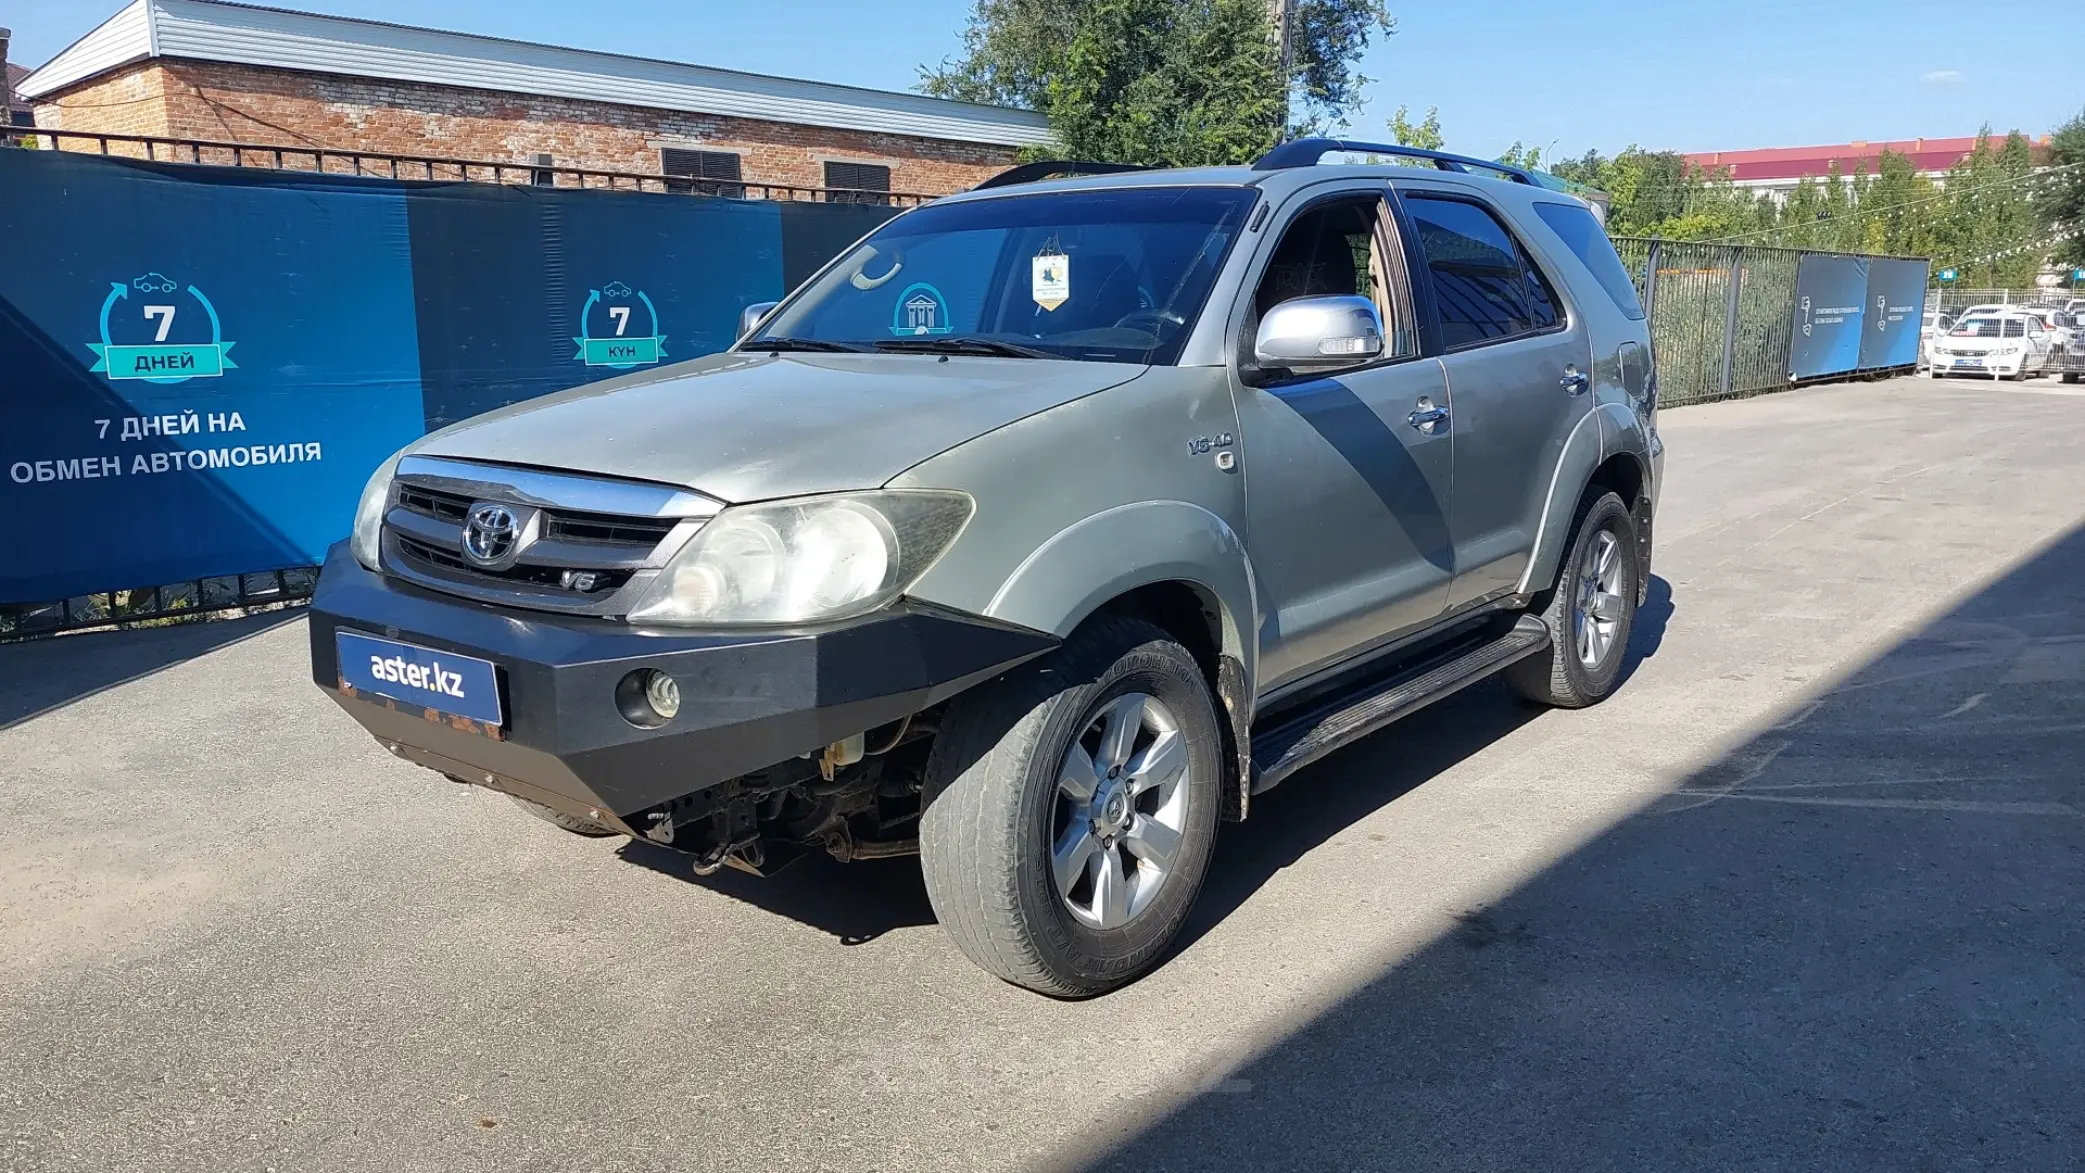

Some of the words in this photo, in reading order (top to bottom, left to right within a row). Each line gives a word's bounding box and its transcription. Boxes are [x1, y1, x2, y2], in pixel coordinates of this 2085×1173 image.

[143, 305, 176, 342] 7
[609, 307, 630, 336] 7
[134, 351, 195, 373] ДНЕЙ
[94, 418, 111, 439] 7
[120, 409, 200, 441] ДНЕЙ
[208, 412, 246, 433] НА
[10, 456, 122, 483] ОБМЕН
[131, 442, 322, 476] АВТОМОБИЛЯ
[561, 570, 597, 590] V6
[370, 655, 465, 698] aster.kz
